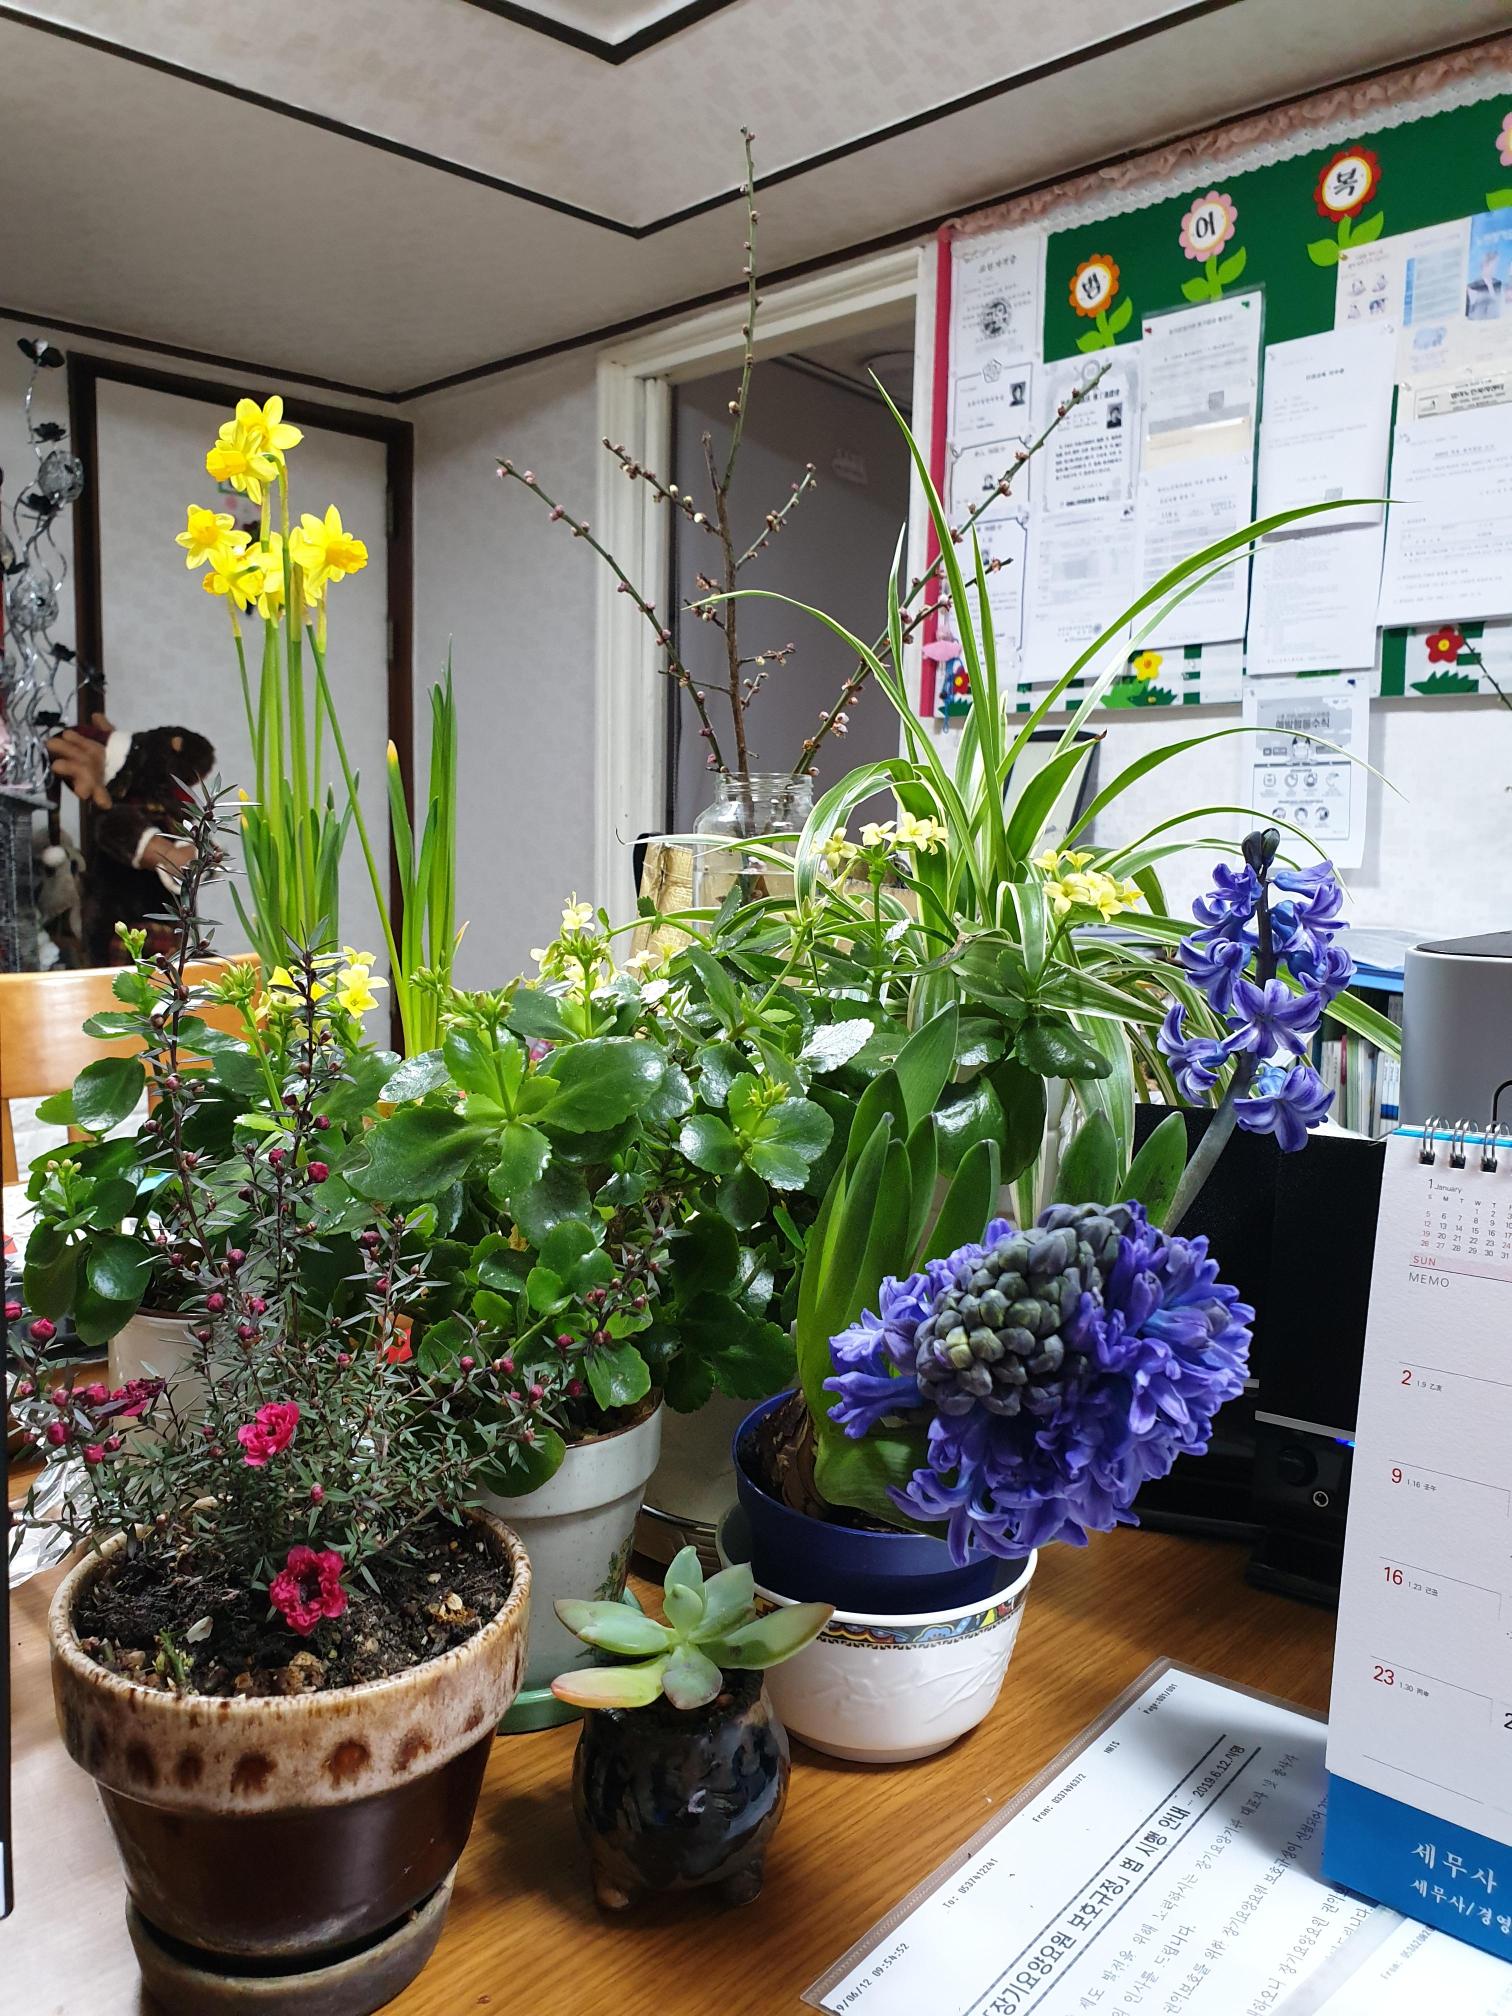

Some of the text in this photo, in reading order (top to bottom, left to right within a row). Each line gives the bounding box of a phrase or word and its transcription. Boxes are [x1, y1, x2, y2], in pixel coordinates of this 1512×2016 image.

[1195, 211, 1217, 239] 어
[1334, 167, 1358, 196] 복
[1428, 1178, 1462, 1194] 1 January
[1413, 1255, 1436, 1266] SUN
[1408, 1272, 1450, 1288] MEMO
[1401, 1369, 1412, 1386] 2
[1391, 1467, 1403, 1484] 9
[1384, 1566, 1404, 1586] 16
[1373, 1664, 1395, 1686] 23
[1067, 1876, 1130, 1931] 보호규정」
[1120, 1857, 1144, 1872] 법
[1135, 1831, 1167, 1857] 시행
[1158, 1806, 1191, 1830] 안내
[1410, 1843, 1498, 1894] 세무사
[942, 1896, 959, 1907] To:
[1133, 1924, 1159, 1944] 위해
[872, 1943, 909, 1976] 09:54:52
[1124, 1925, 1196, 2003] 인사를 드립니다.
